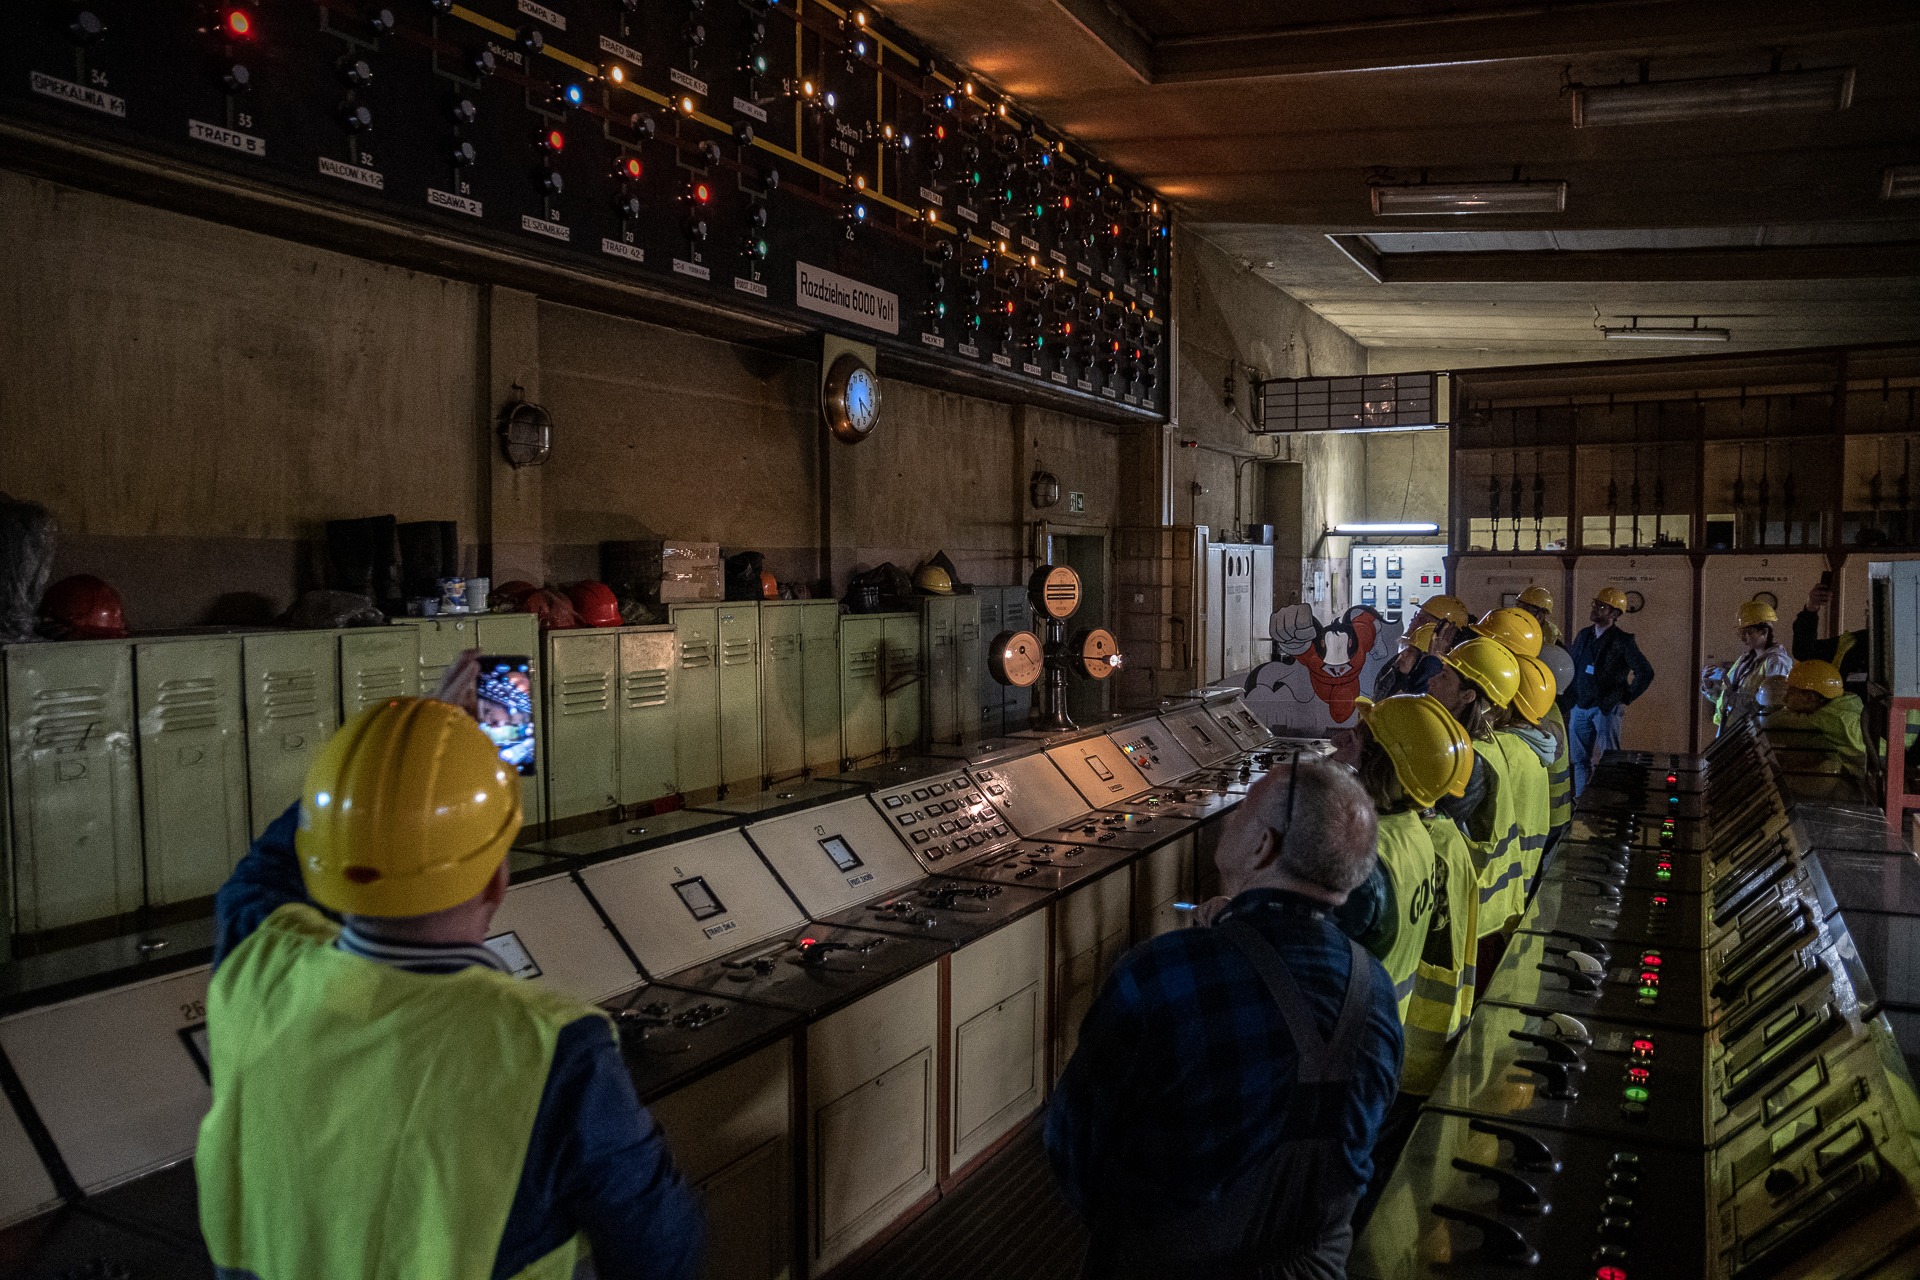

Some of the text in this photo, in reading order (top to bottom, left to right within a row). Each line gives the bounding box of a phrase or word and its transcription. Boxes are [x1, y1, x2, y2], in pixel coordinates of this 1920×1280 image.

[522, 1, 557, 24] POMPA 3
[625, 26, 630, 36] 6
[486, 41, 514, 60] Sekcja
[601, 39, 624, 55] TRAFO
[693, 60, 698, 69] 7
[91, 68, 109, 87] 34
[238, 112, 252, 128] 33
[836, 118, 858, 140] System
[196, 124, 256, 151] TRAFO 5
[360, 152, 374, 167] 32
[460, 181, 471, 195] 31
[432, 191, 476, 213] SSAWA 2
[551, 208, 560, 221] 30
[625, 231, 634, 243] 29
[605, 240, 640, 258] TRAFO 42
[754, 271, 761, 281] 27
[800, 271, 895, 323] Rozdzielnia 6000 Volt
[1508, 560, 1512, 568] 1
[1630, 560, 1636, 568] 2
[1761, 558, 1768, 567] 3
[814, 825, 826, 836] 27
